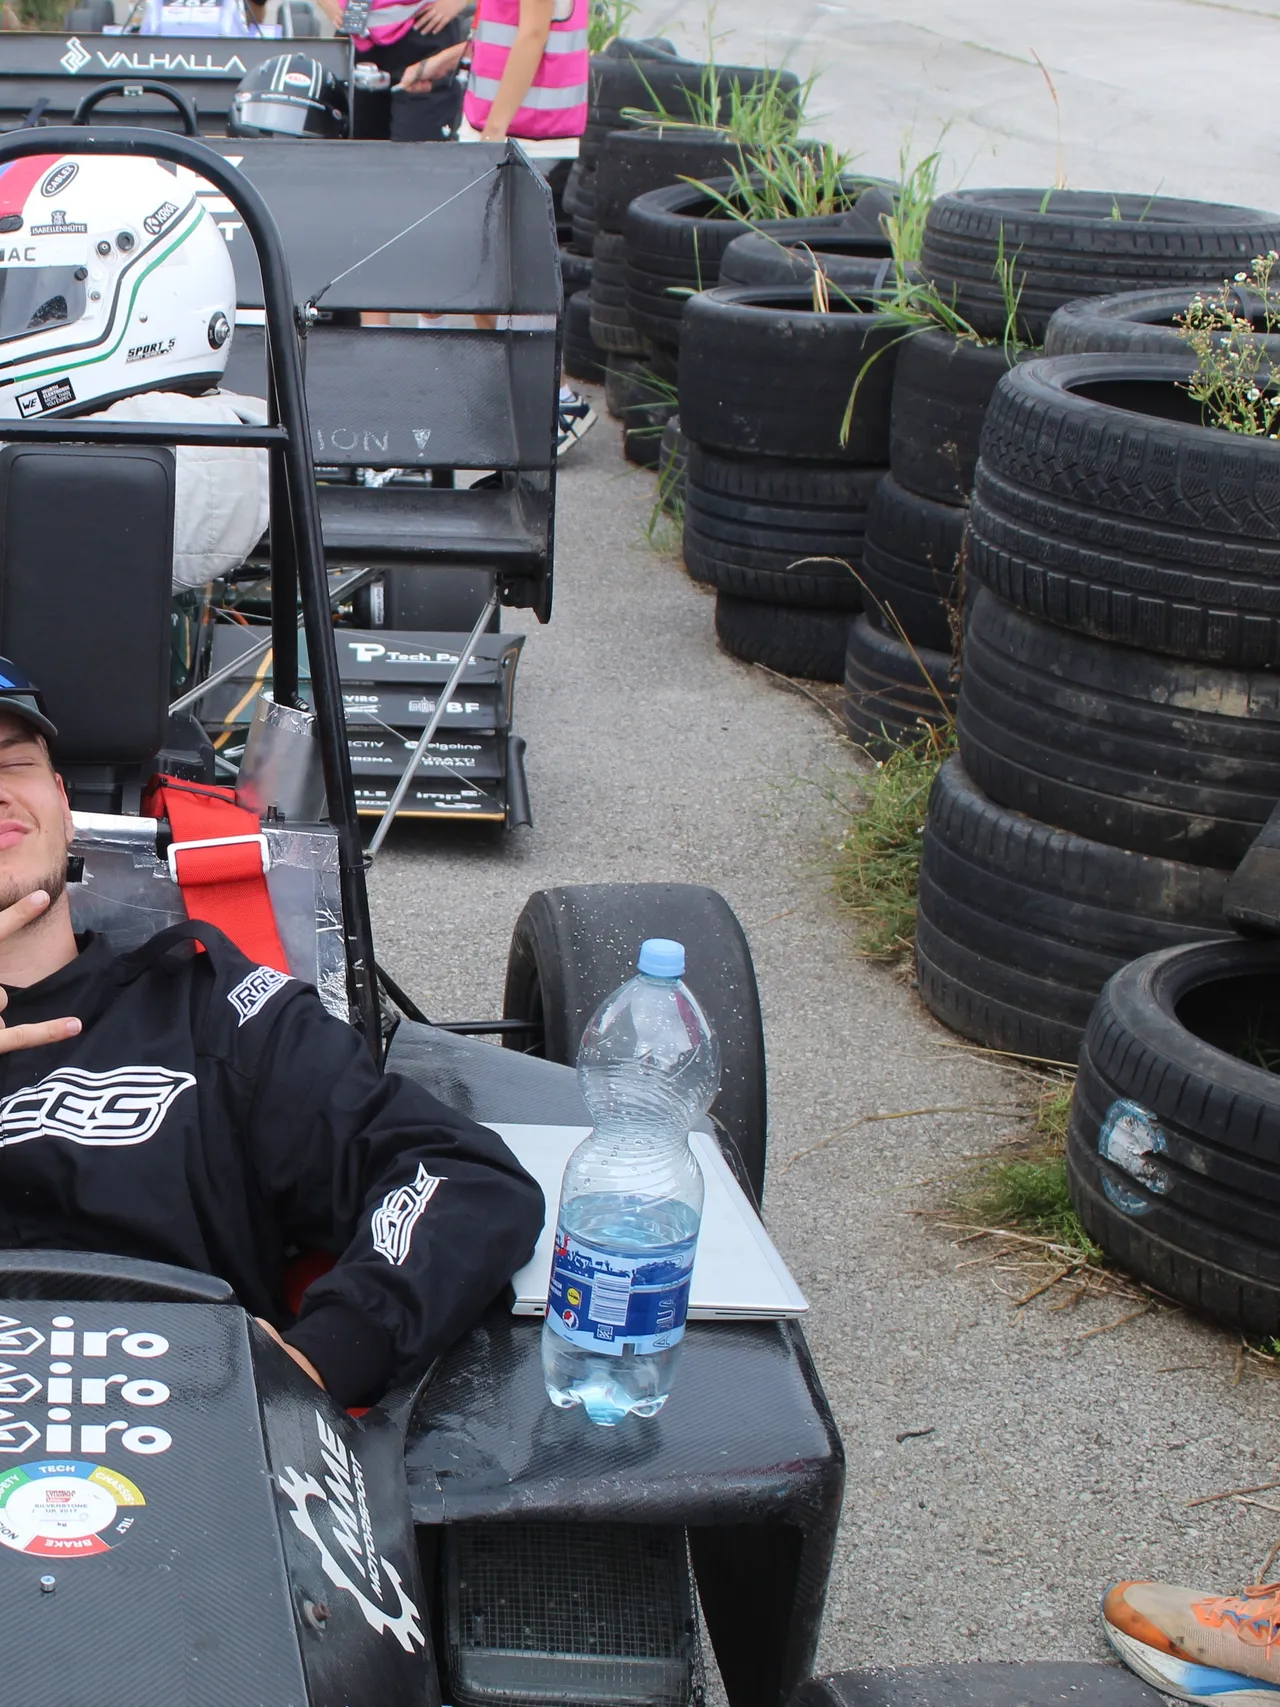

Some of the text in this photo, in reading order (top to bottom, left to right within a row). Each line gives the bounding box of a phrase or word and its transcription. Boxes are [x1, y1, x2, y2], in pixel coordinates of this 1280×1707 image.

[96, 52, 247, 73] VALHALLA
[46, 165, 74, 193] CABLEX
[155, 202, 177, 224] KRKA
[31, 224, 86, 234] ISABELLENHÜTTE
[127, 341, 164, 357] SPORT
[387, 651, 431, 662] Tech
[436, 653, 477, 662] Pat
[342, 694, 379, 703] VIRO
[446, 702, 480, 713] BF
[347, 740, 385, 748] ECTIV
[427, 742, 482, 751] elgoline
[38, 1464, 76, 1474] TECH
[116, 1515, 135, 1535] TILT
[349, 1449, 384, 1602] MOTORSPORT
[44, 1538, 93, 1548] BRAKE
